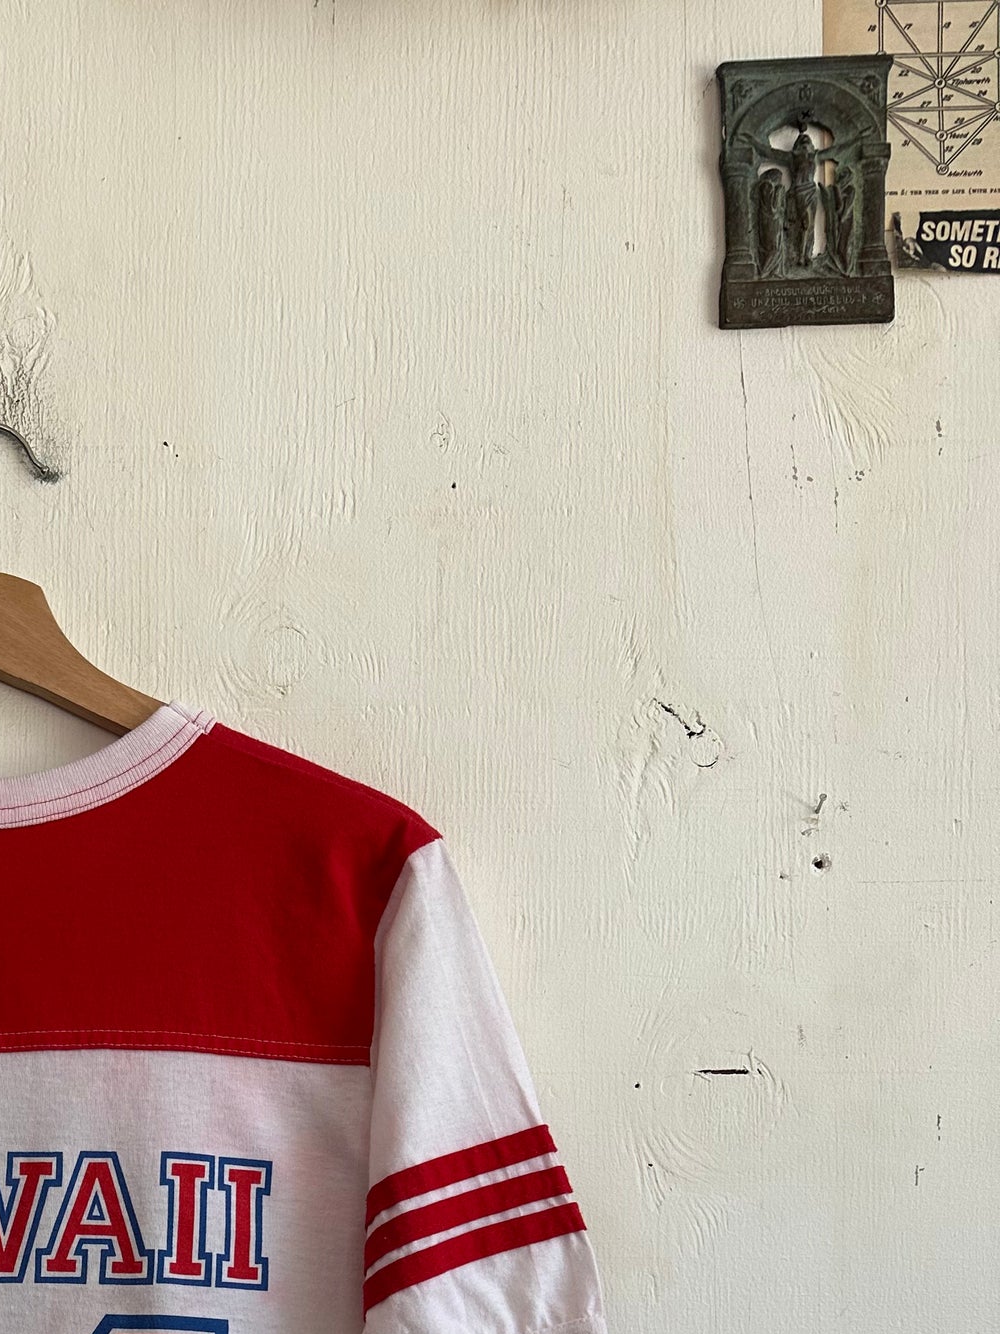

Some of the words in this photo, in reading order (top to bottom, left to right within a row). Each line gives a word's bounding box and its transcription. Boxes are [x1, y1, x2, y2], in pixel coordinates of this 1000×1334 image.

[921, 220, 1000, 243] SOMET
[948, 244, 977, 268] SO
[983, 246, 1000, 269] R
